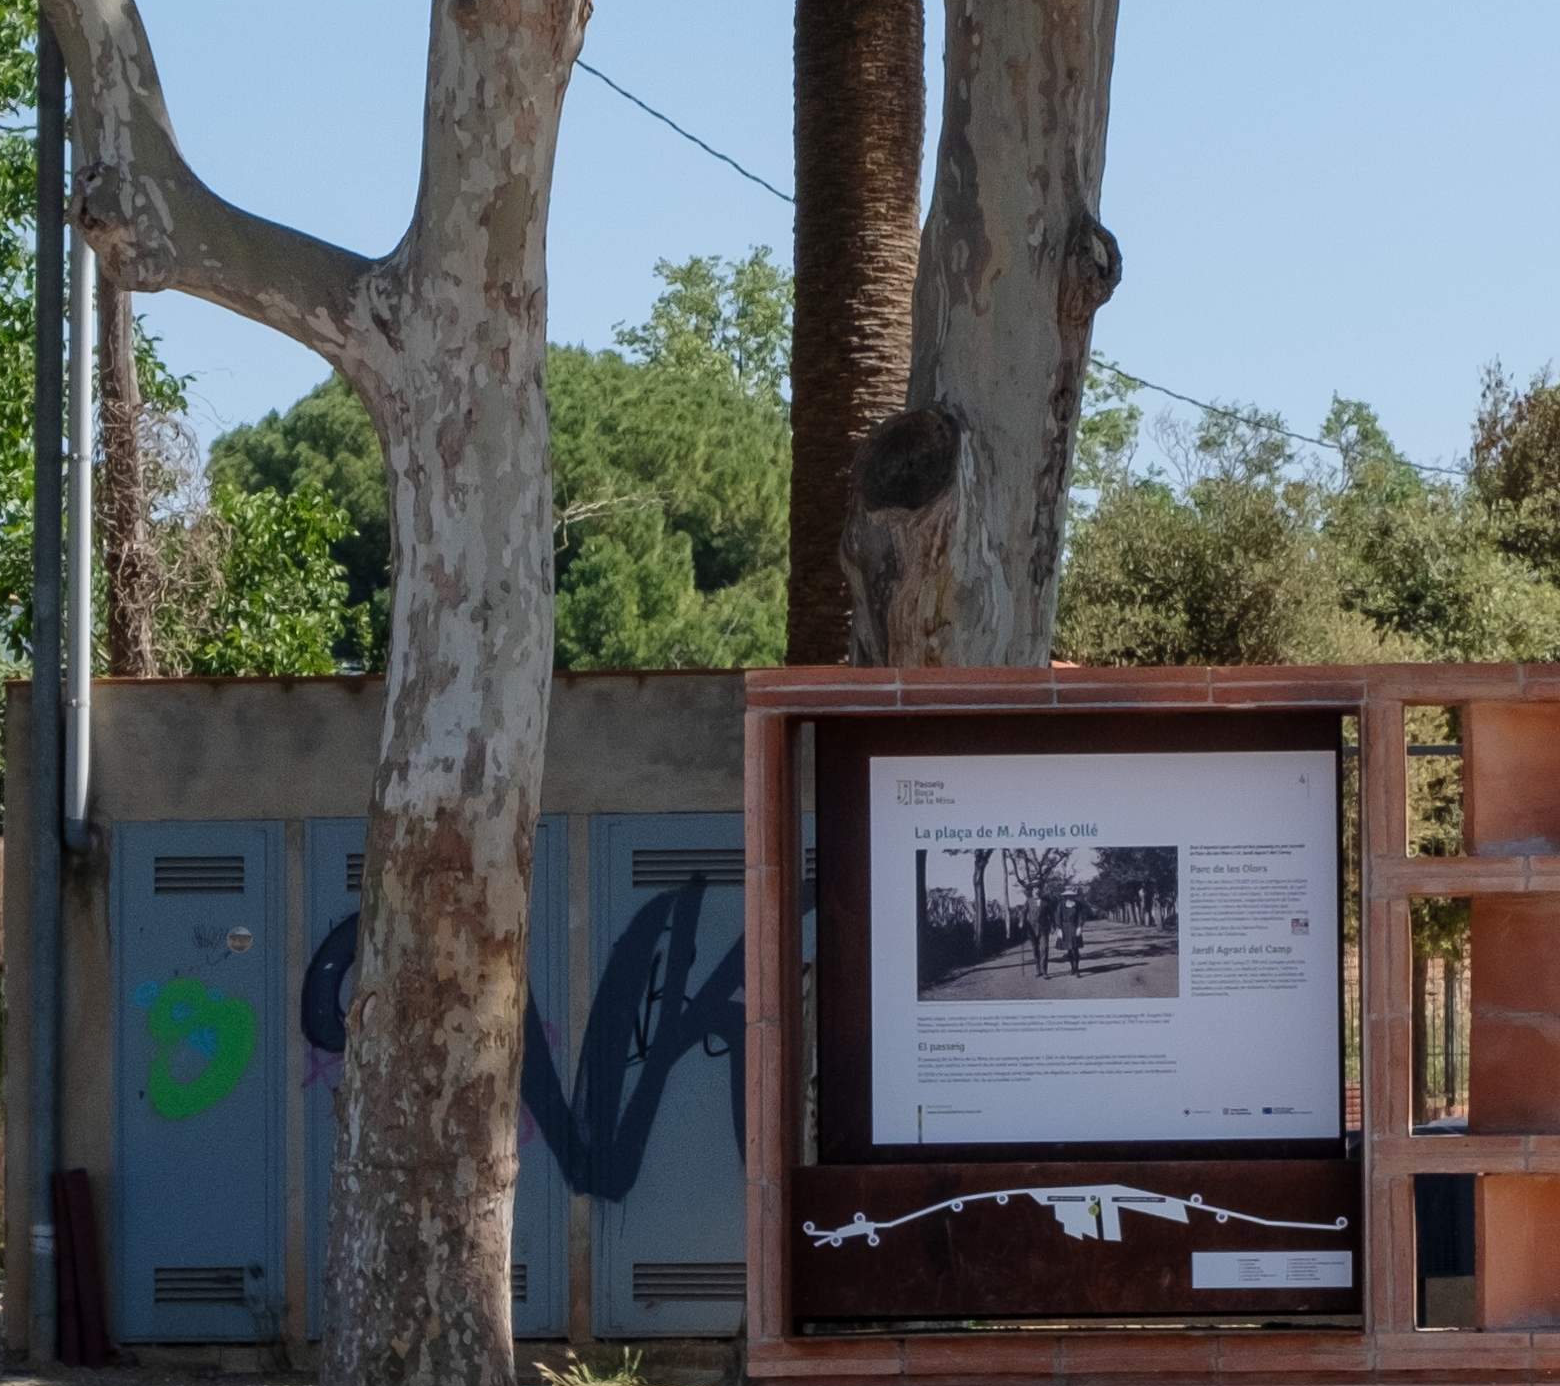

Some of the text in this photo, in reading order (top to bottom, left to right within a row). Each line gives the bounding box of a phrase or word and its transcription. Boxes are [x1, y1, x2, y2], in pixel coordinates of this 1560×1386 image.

[915, 821, 1099, 842] La plaça de M. Àngels Ollé
[1190, 864, 1211, 874] Parc
[1213, 864, 1225, 874] de
[1227, 864, 1240, 874] les
[1216, 944, 1247, 956] Agrari
[1248, 944, 1264, 954] del
[1265, 944, 1293, 956] Camp
[918, 1042, 965, 1053] El passeig
